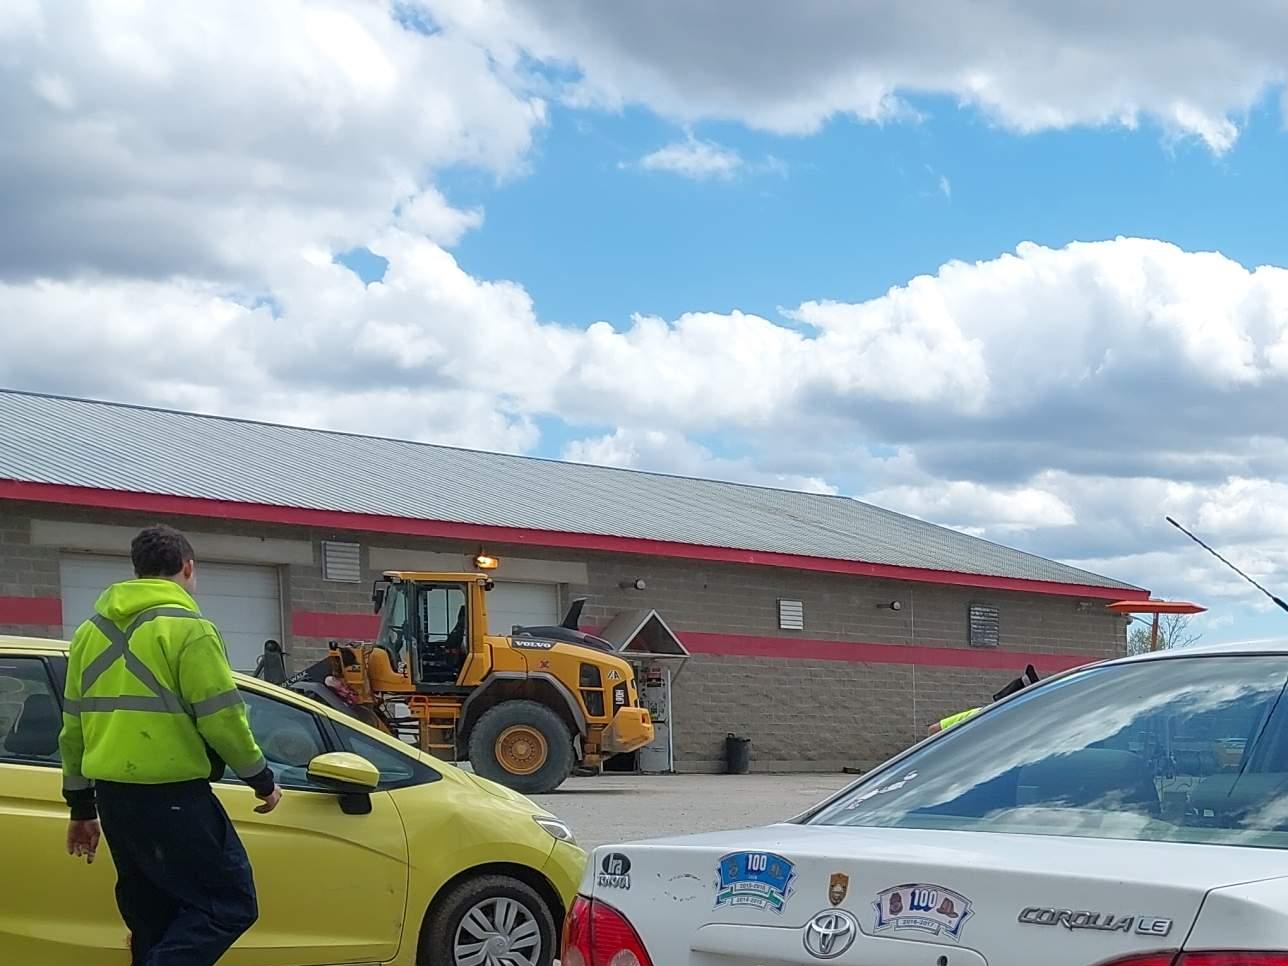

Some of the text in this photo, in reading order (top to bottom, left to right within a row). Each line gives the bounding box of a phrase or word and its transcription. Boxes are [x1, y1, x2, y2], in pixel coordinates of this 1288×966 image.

[746, 853, 767, 872] 100
[911, 888, 938, 909] 100
[1018, 908, 1172, 936] COROLLA LE
